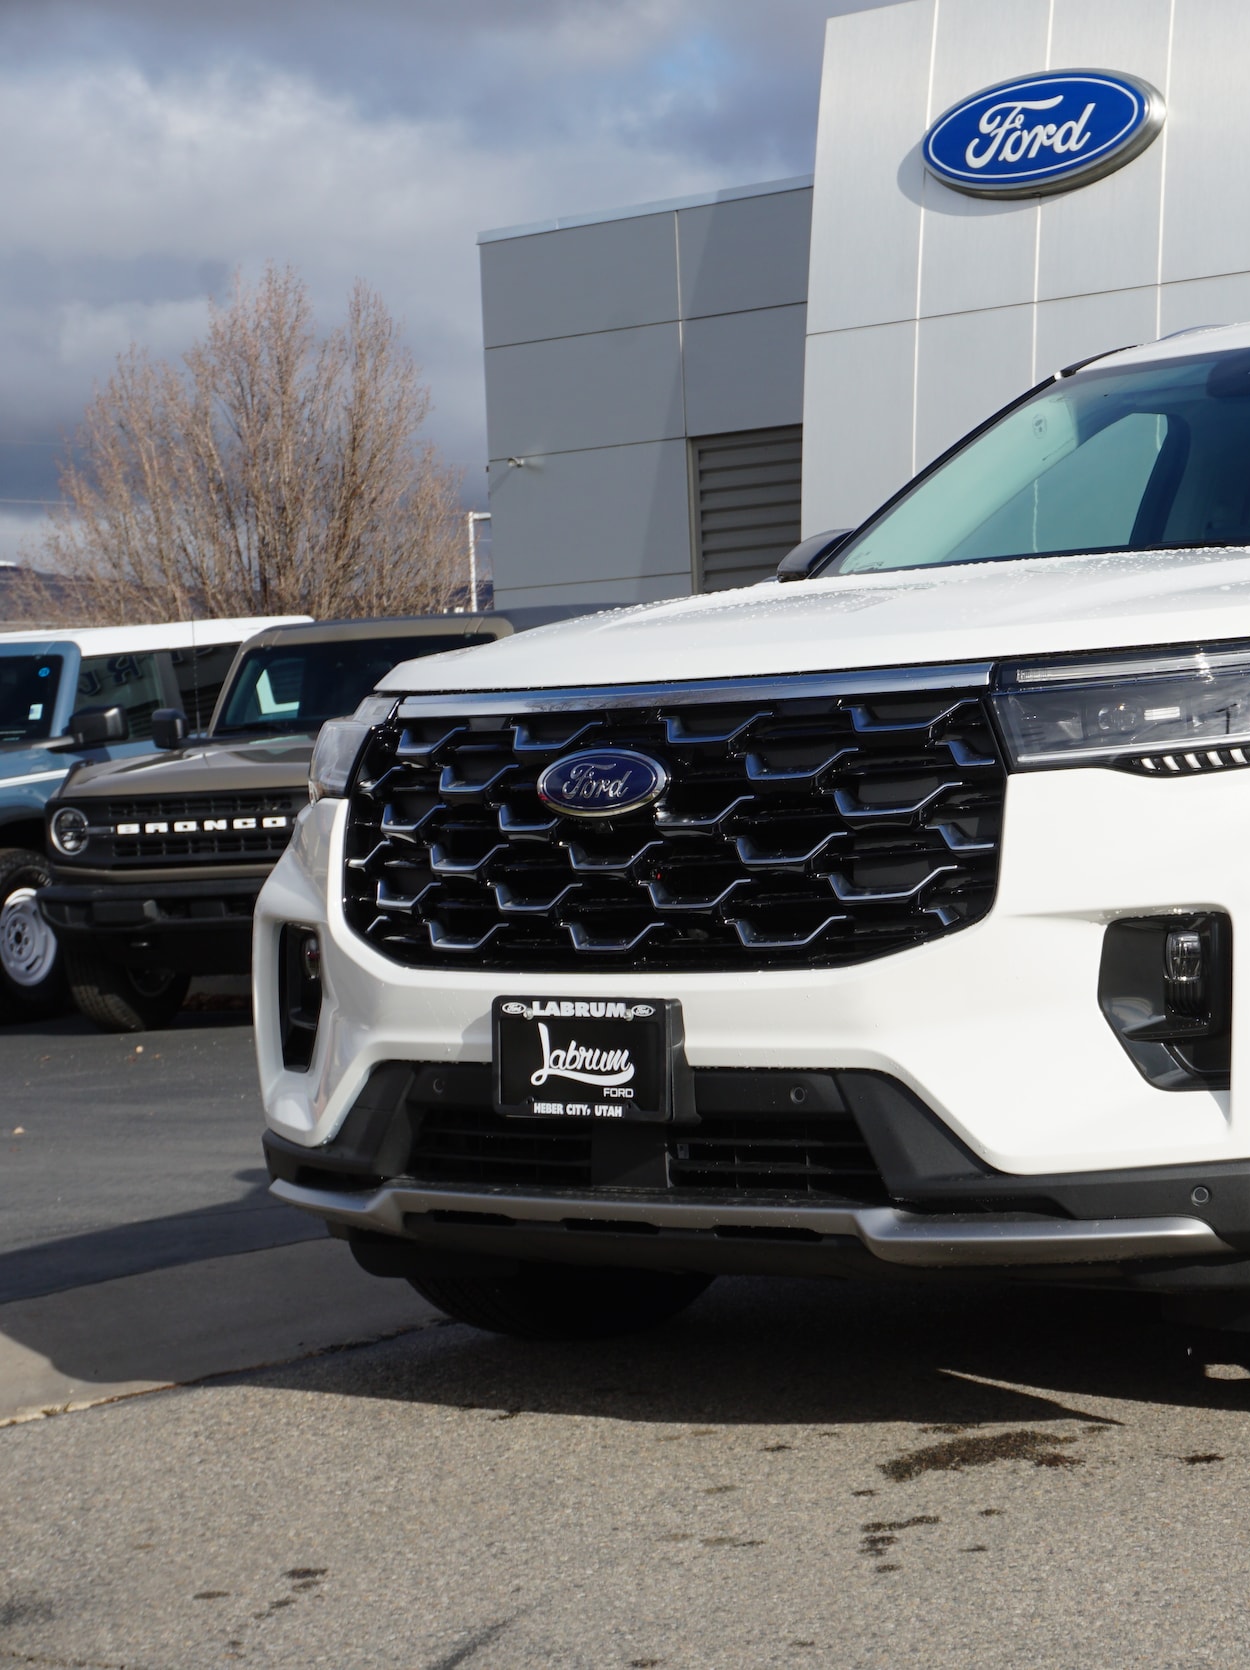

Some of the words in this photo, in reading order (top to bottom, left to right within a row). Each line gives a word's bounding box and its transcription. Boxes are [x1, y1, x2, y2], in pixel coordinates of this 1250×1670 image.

[965, 95, 1096, 168] Ford
[562, 763, 632, 799] Ford
[117, 816, 287, 835] BRONCO
[532, 1001, 627, 1018] LABRUM
[530, 1022, 635, 1086] Labrum
[603, 1088, 634, 1098] FORD
[533, 1103, 564, 1115] HEBER
[566, 1104, 591, 1116] CITY,
[594, 1105, 623, 1117] UTAH
